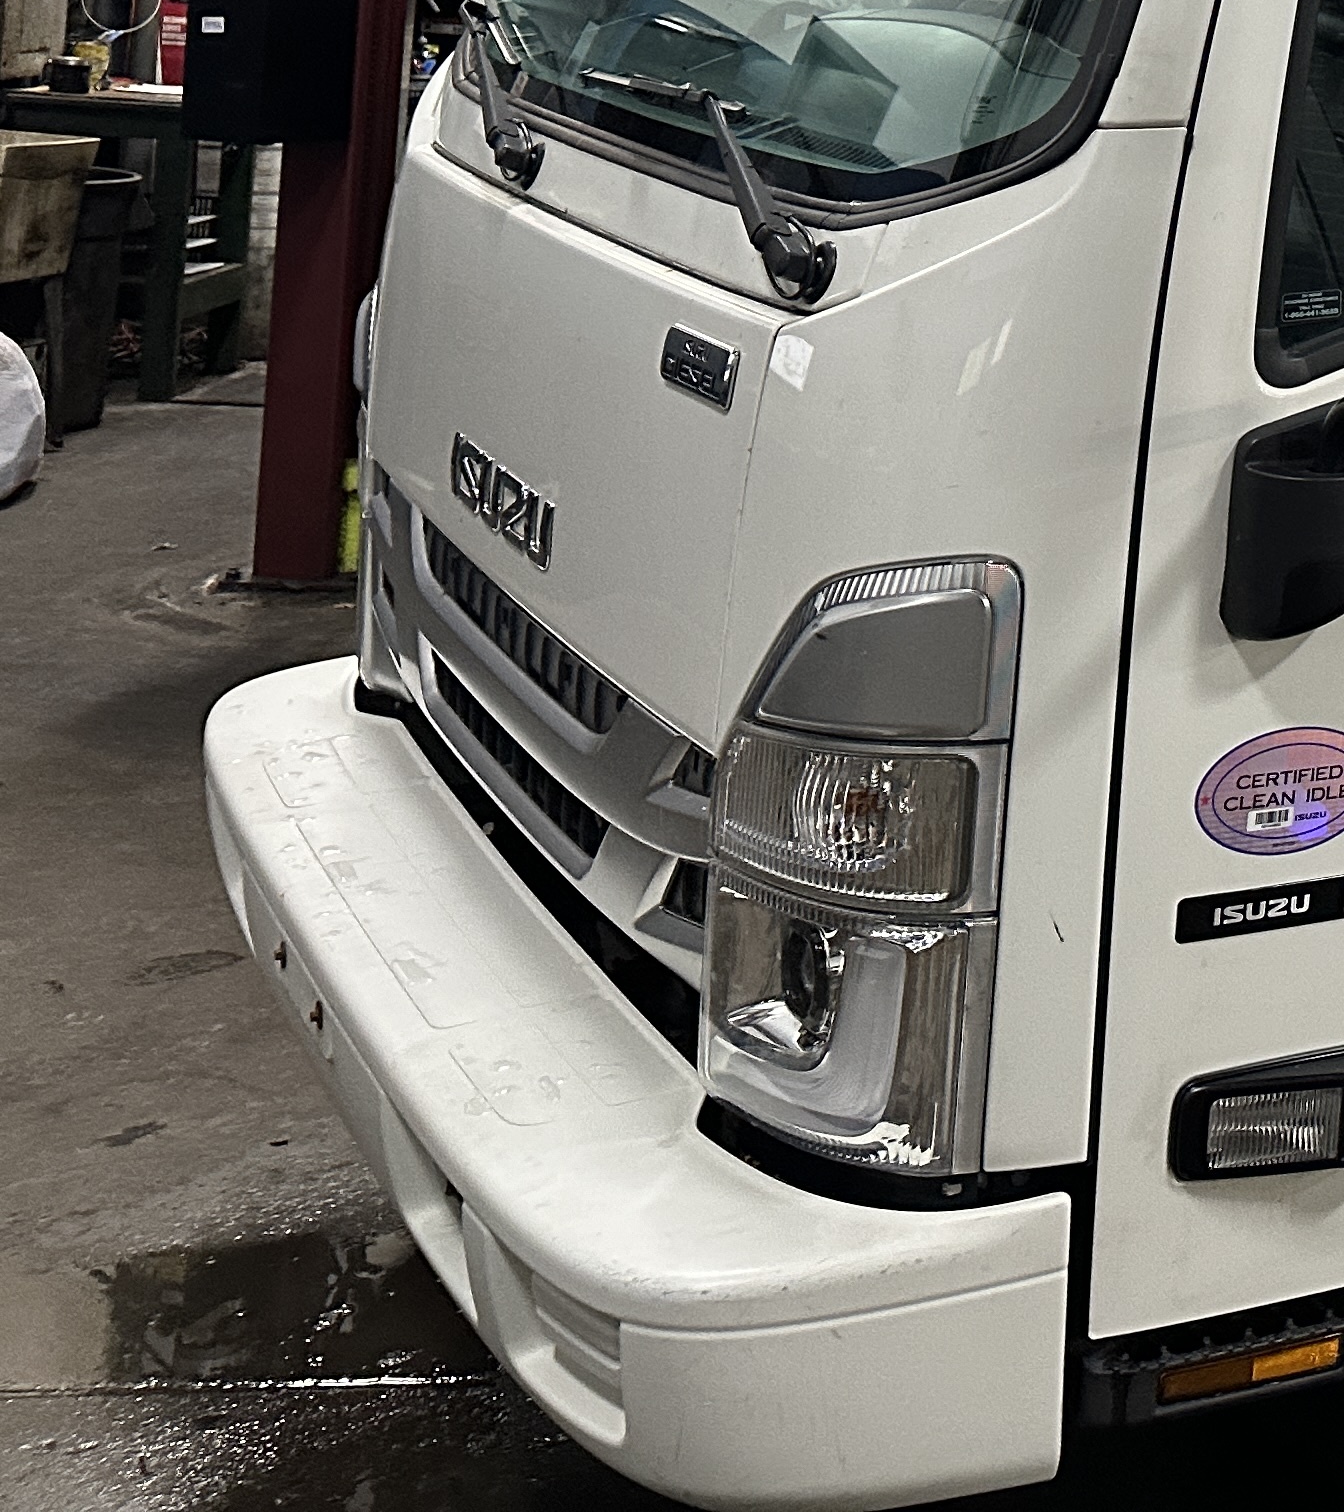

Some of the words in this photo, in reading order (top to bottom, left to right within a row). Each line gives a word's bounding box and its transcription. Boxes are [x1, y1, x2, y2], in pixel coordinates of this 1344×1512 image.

[450, 431, 556, 574] ISUZU
[1235, 764, 1344, 790] CERTIFIED
[1222, 790, 1296, 812] CLEAN
[1294, 810, 1327, 822] ISUZU
[1212, 893, 1311, 927] ISUZU
